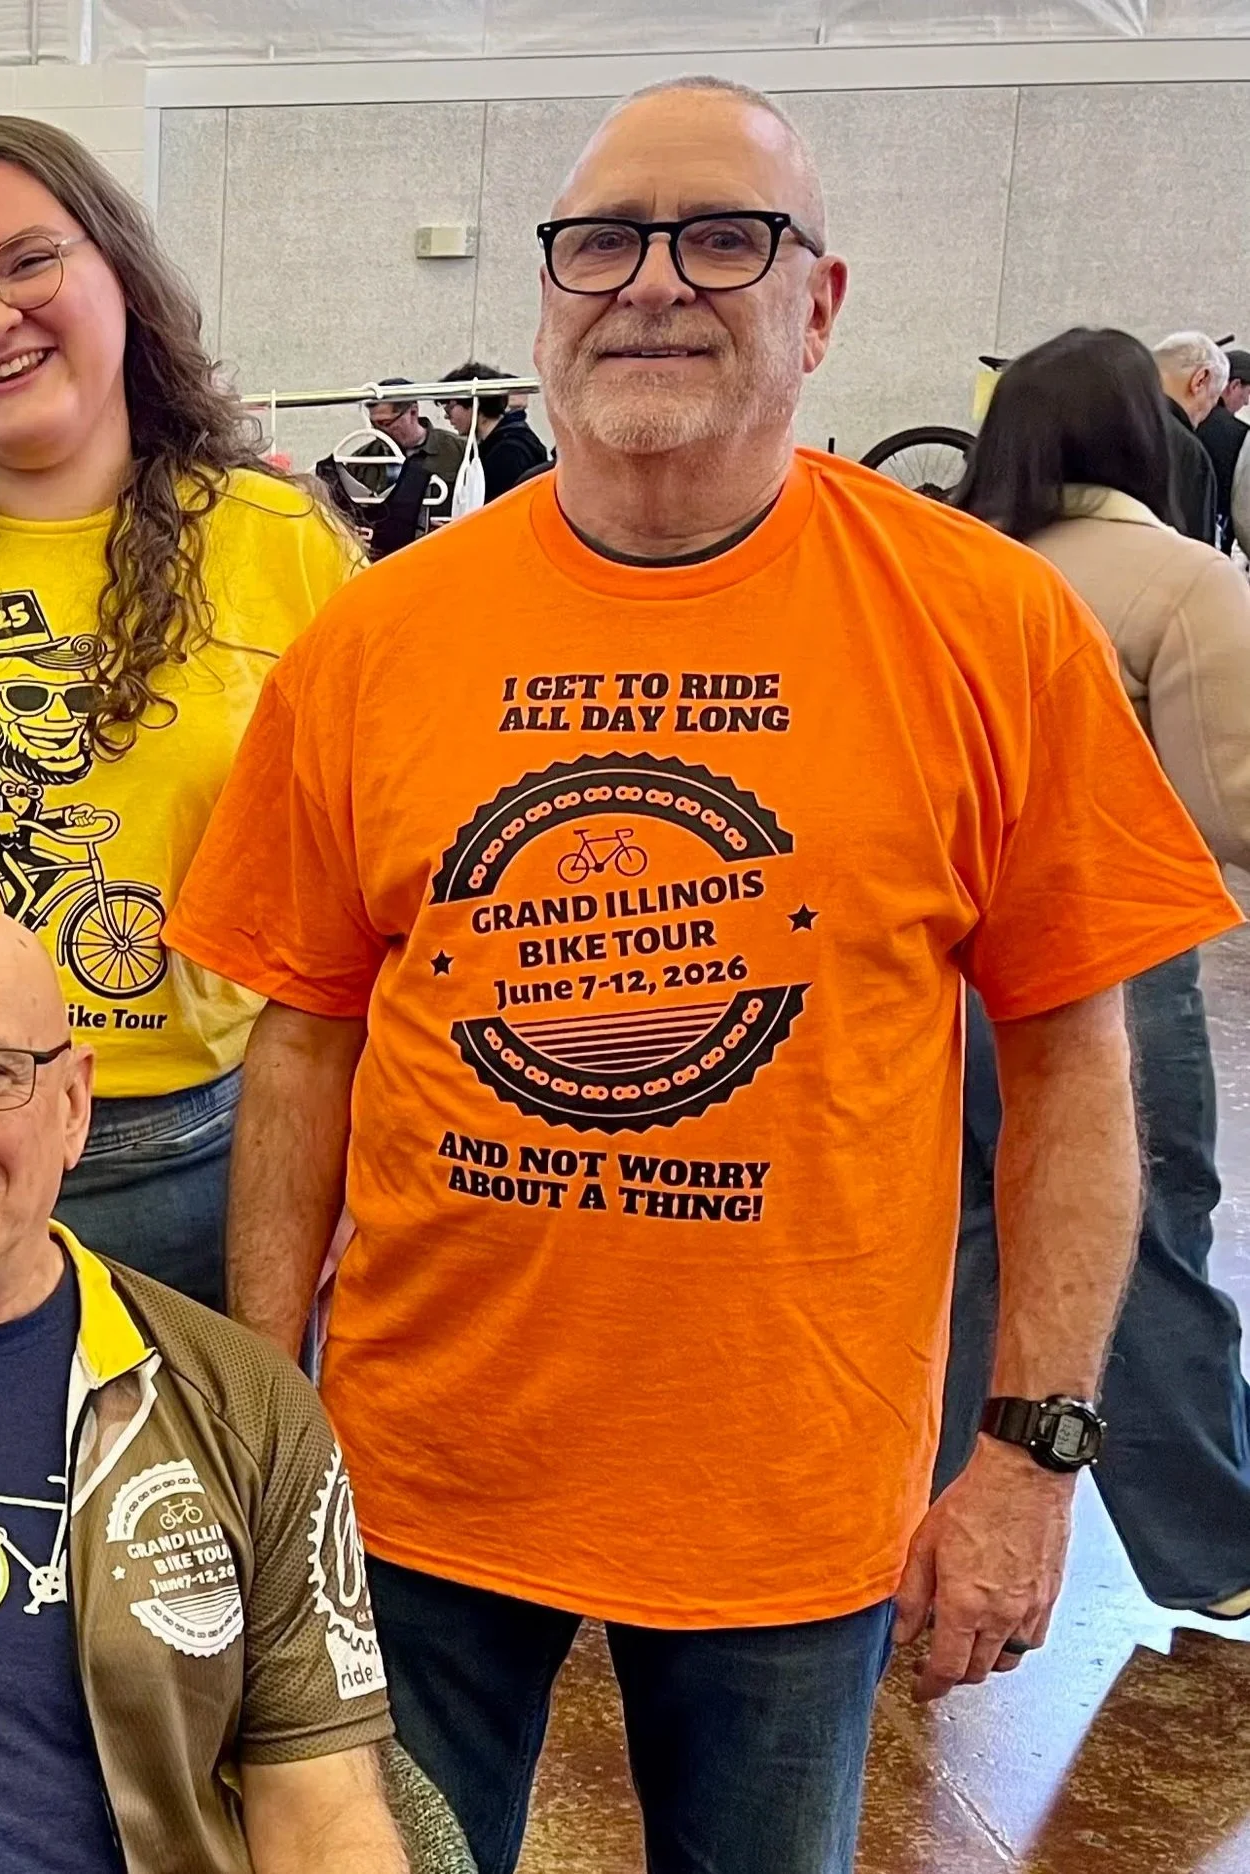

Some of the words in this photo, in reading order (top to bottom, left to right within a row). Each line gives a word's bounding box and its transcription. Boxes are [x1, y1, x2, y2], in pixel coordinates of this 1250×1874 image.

[503, 677, 518, 701] I
[526, 674, 605, 700] GET
[615, 673, 669, 699] TO
[679, 673, 780, 700] RIDE
[499, 706, 570, 732] ALL
[580, 705, 665, 732] DAY
[674, 705, 790, 732] LONG
[472, 894, 597, 934] GRAND
[606, 869, 765, 919] ILLINOIS
[519, 933, 606, 968] BIKE
[612, 919, 717, 956] TOUR
[494, 978, 573, 1011] June
[579, 969, 657, 1000] 7-12,
[663, 955, 748, 988] 2026
[112, 1008, 168, 1029] Tour
[438, 1131, 509, 1169] AND
[519, 1146, 607, 1177] NOT
[618, 1153, 771, 1189] WORRY
[449, 1165, 568, 1209] ABOUT
[578, 1184, 607, 1211] A
[618, 1186, 764, 1222] THING!
[127, 1533, 185, 1559] GRAND
[153, 1552, 194, 1575] BIKE
